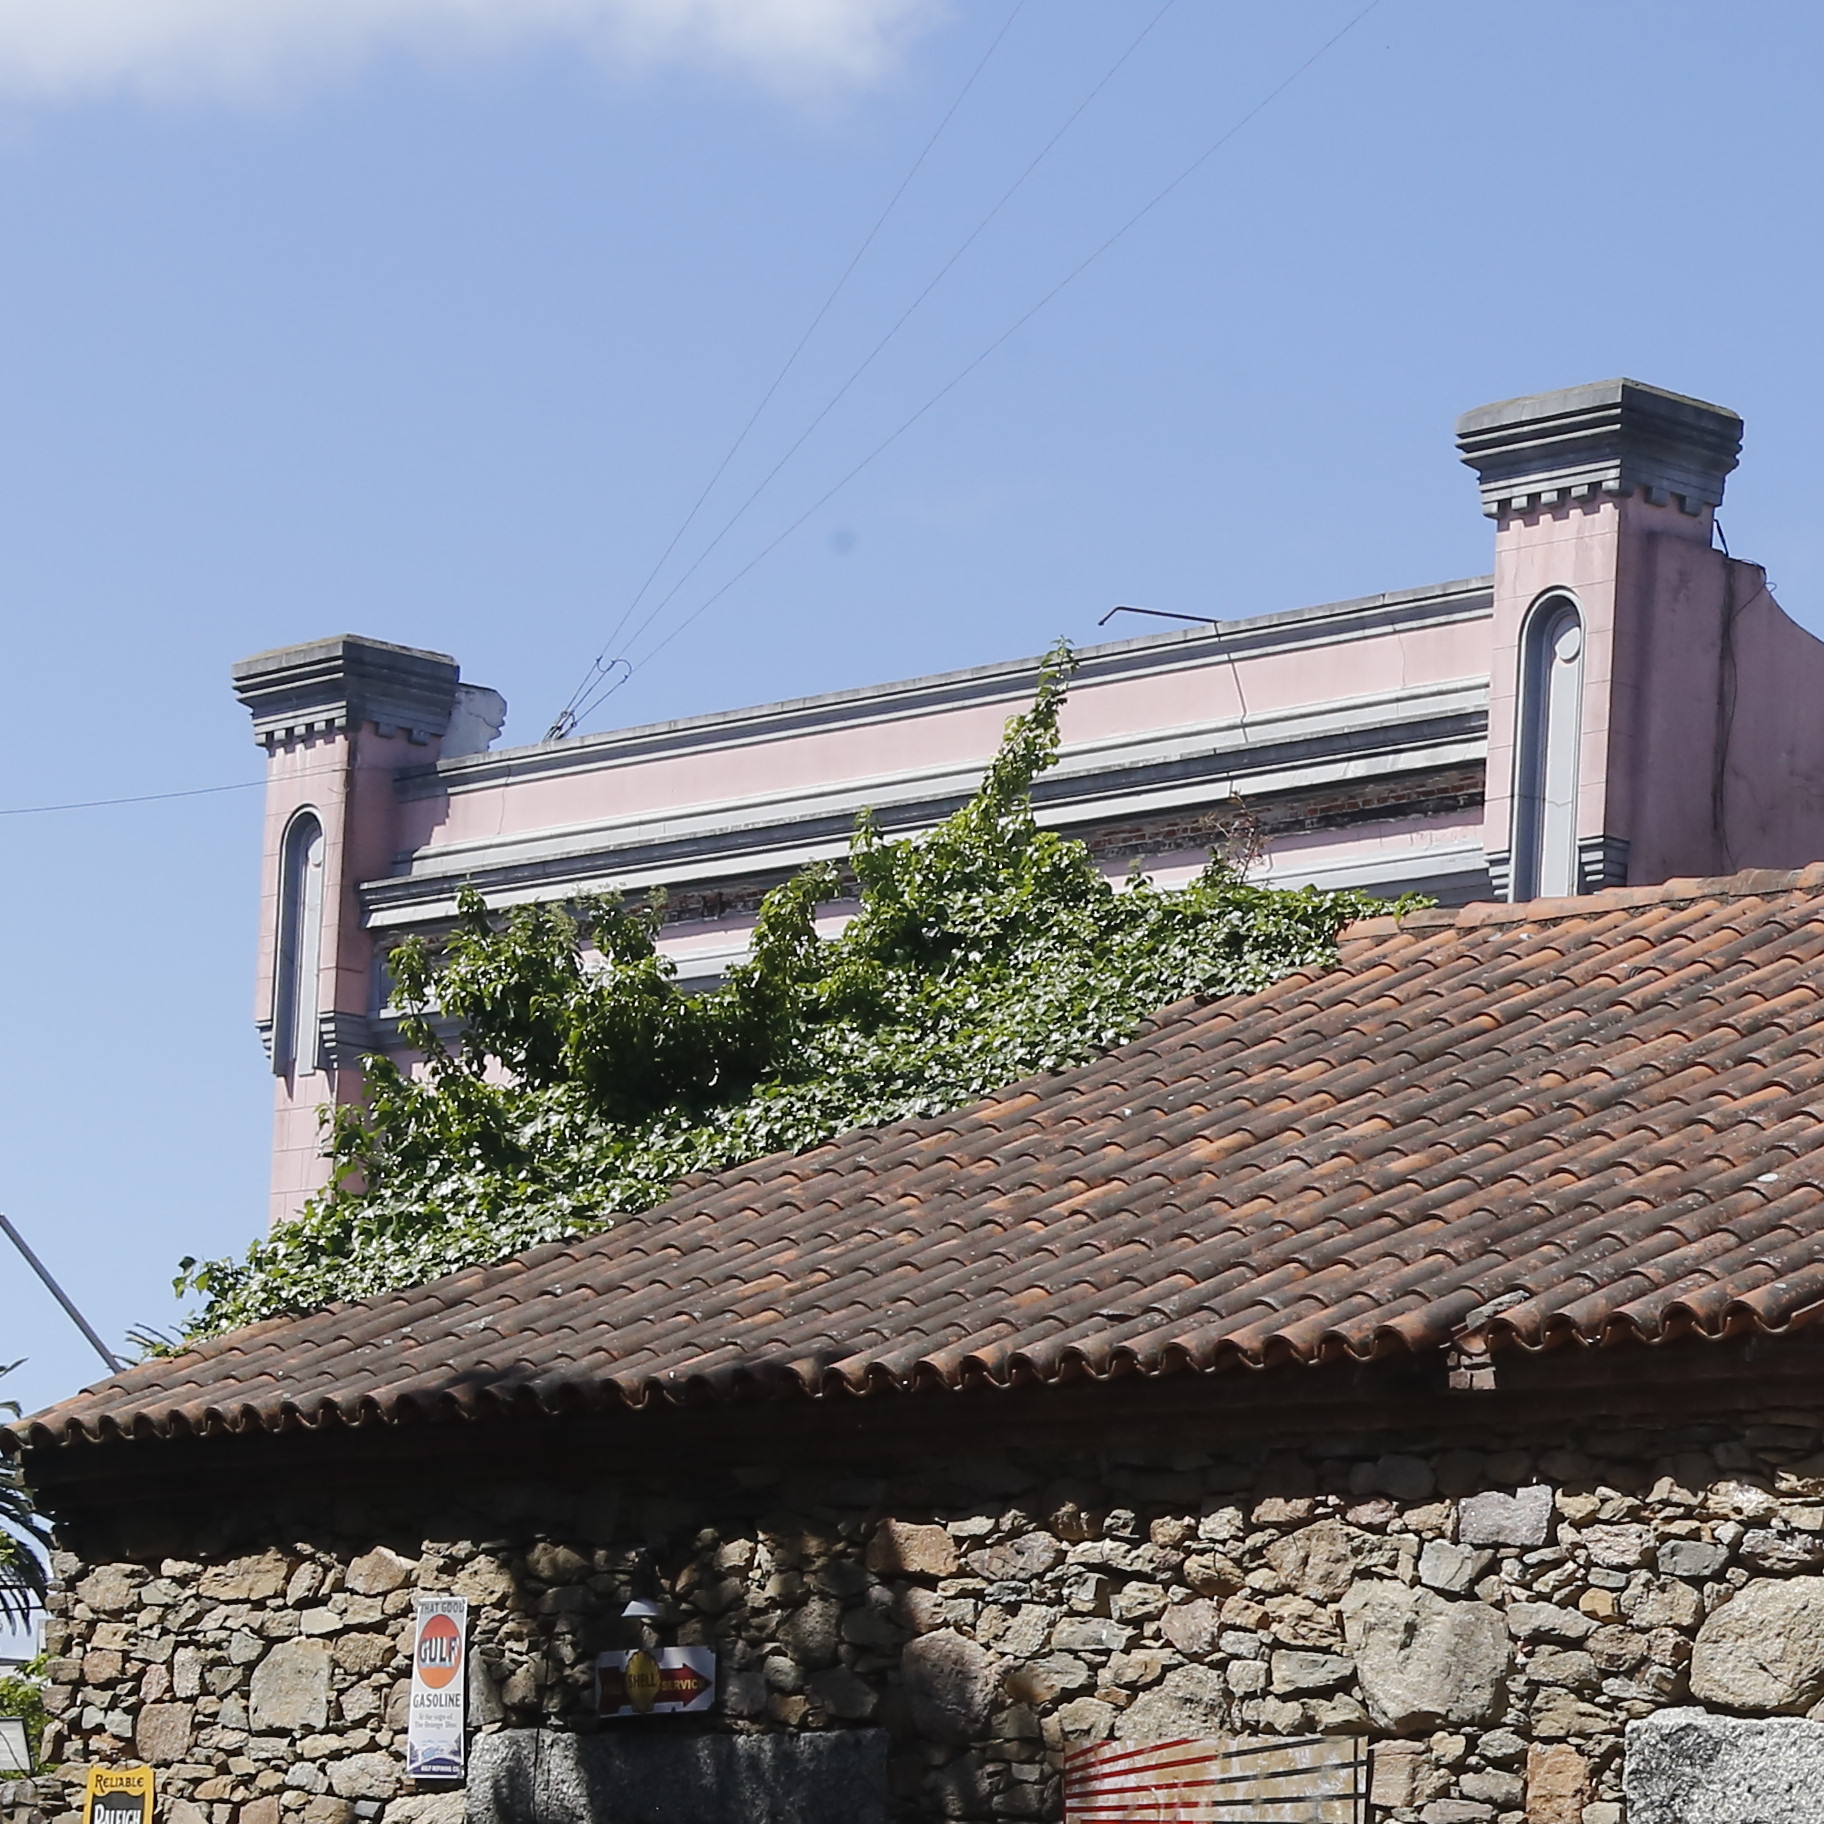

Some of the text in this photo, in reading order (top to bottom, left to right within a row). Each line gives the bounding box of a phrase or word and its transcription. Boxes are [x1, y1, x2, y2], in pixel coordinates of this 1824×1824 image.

[420, 1602, 465, 1614] THAT GOOD
[419, 1636, 459, 1665] GULF
[628, 1673, 657, 1688] SHELL
[413, 1693, 462, 1708] GASOLINE
[95, 1774, 145, 1792] RELIABLE
